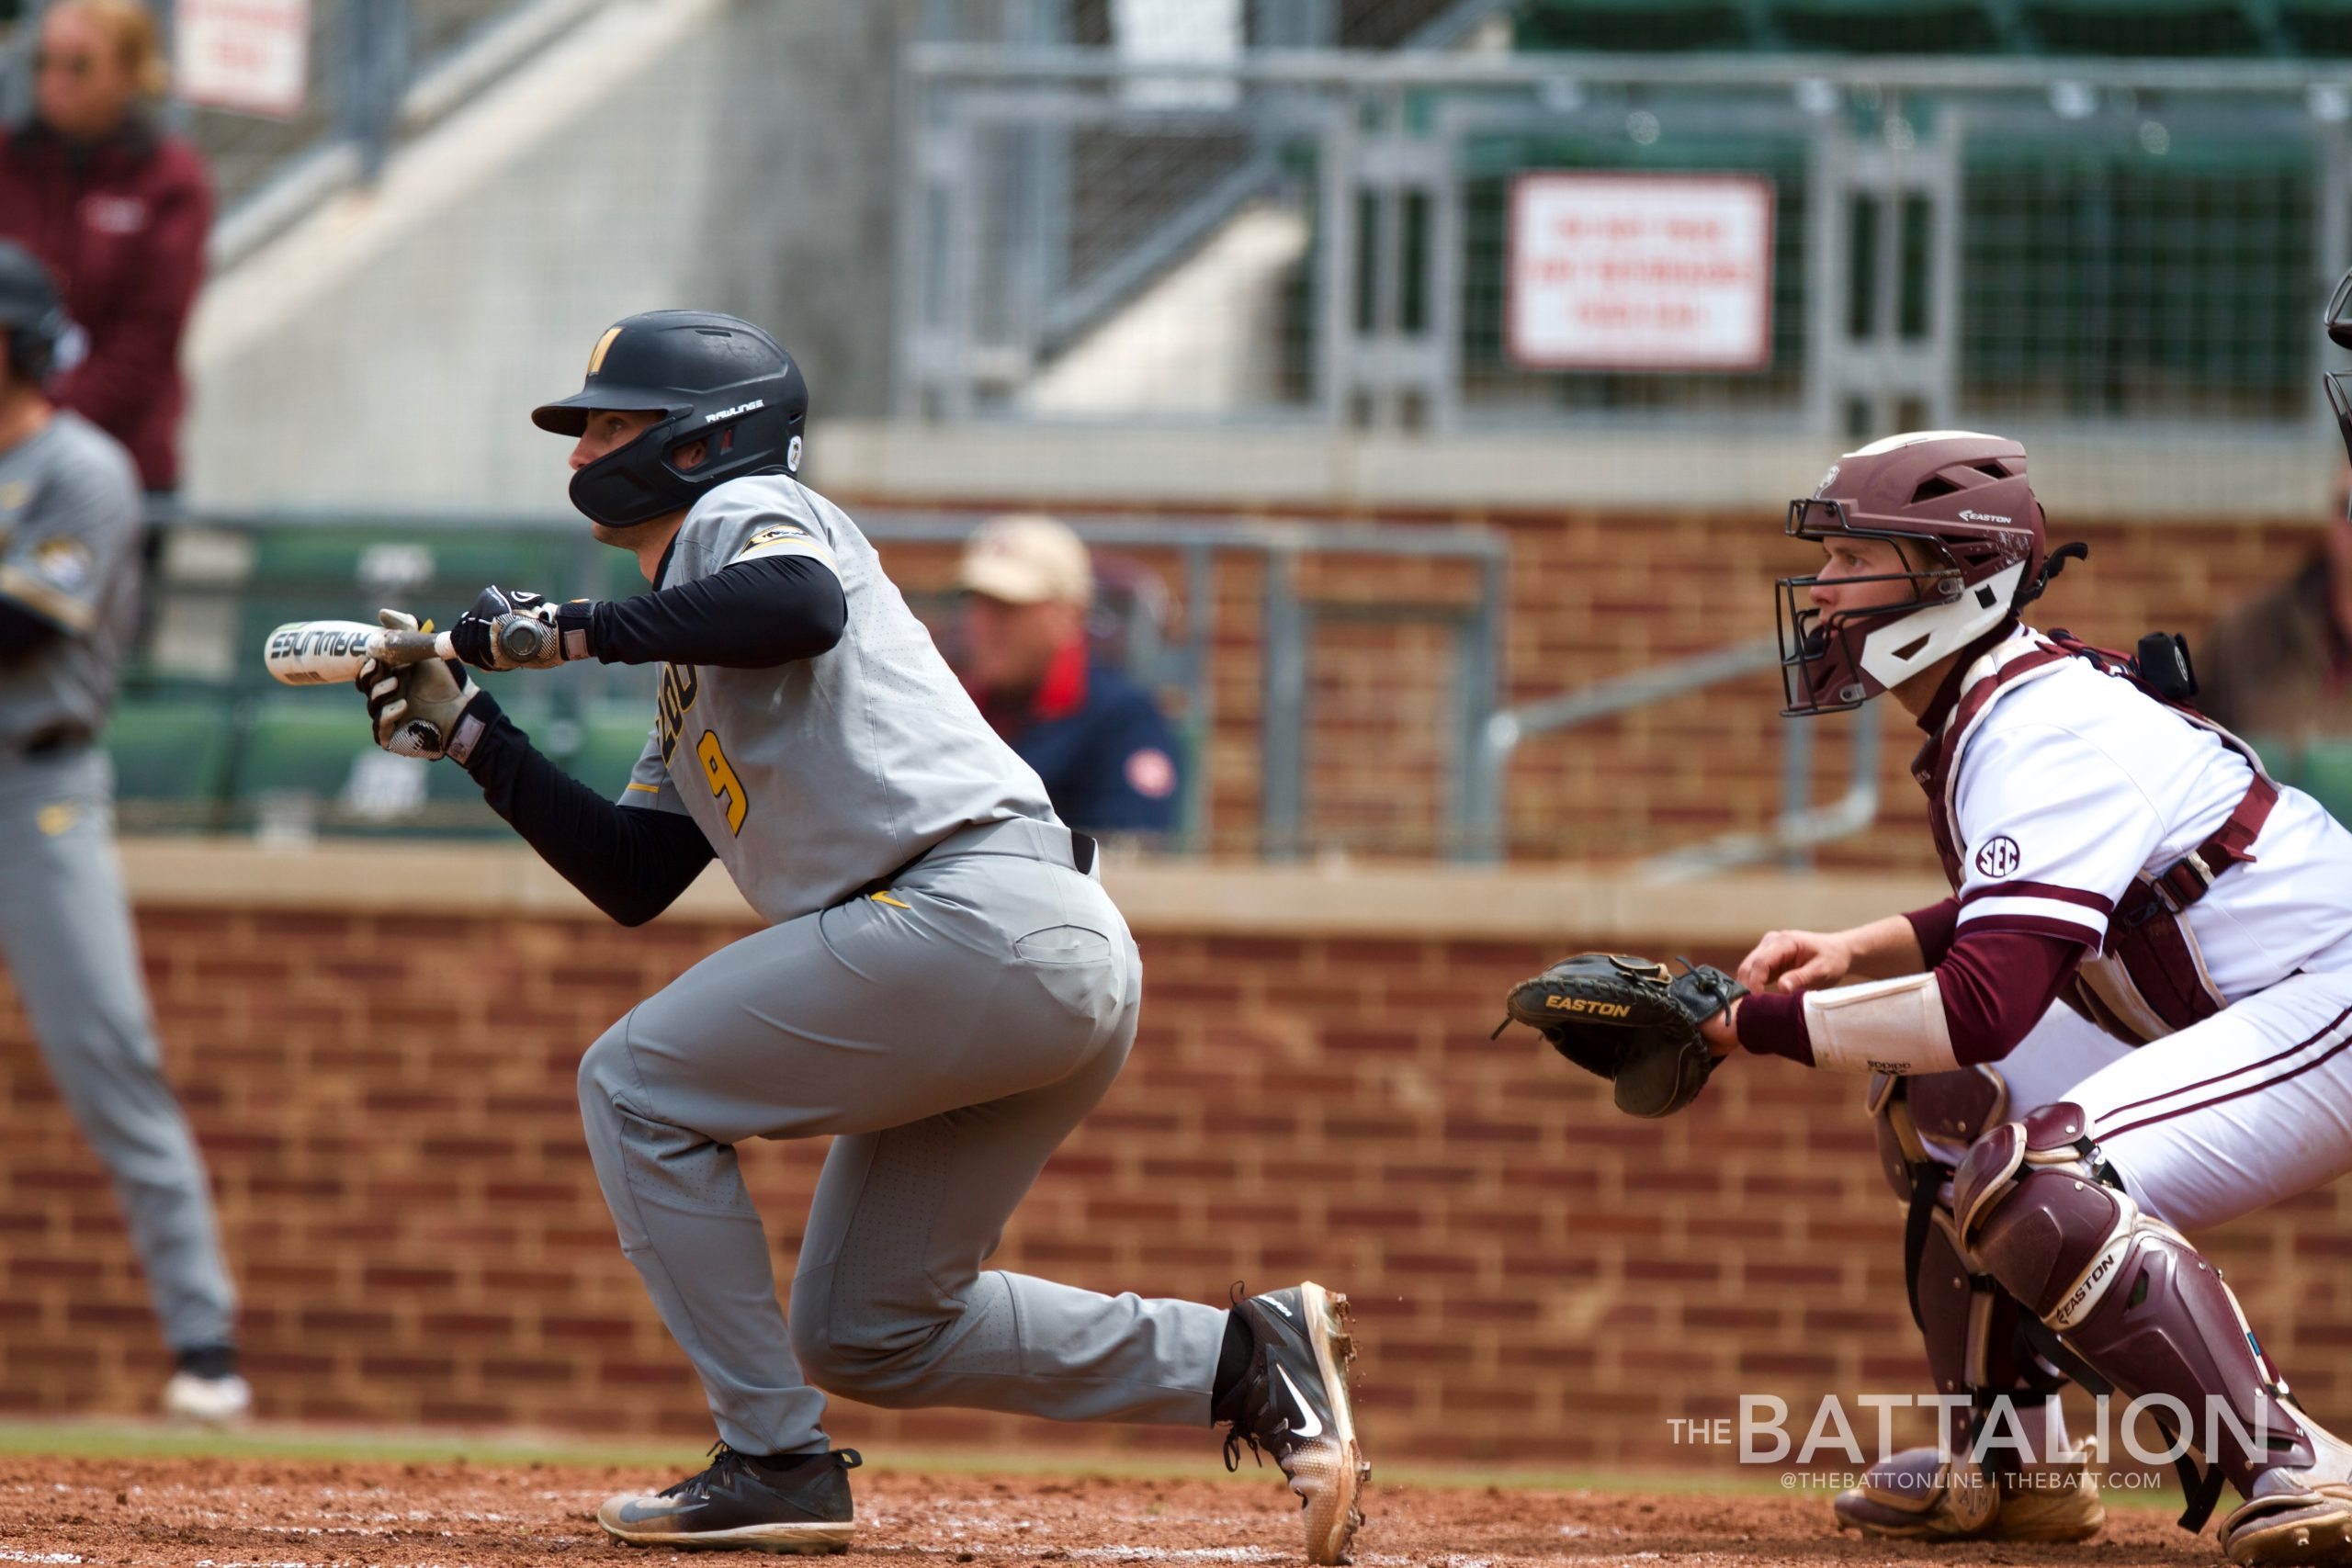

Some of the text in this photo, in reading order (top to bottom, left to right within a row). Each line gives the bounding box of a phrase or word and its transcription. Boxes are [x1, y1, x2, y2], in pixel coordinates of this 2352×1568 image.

[705, 399, 764, 423] RAWLINGS
[1969, 513, 2012, 524] EASTON
[270, 631, 370, 659] RAWLINGS
[696, 728, 749, 839] 9
[1978, 837, 2018, 876] SEC
[1545, 995, 1631, 1018] EASTON
[2064, 1254, 2115, 1317] EASTON
